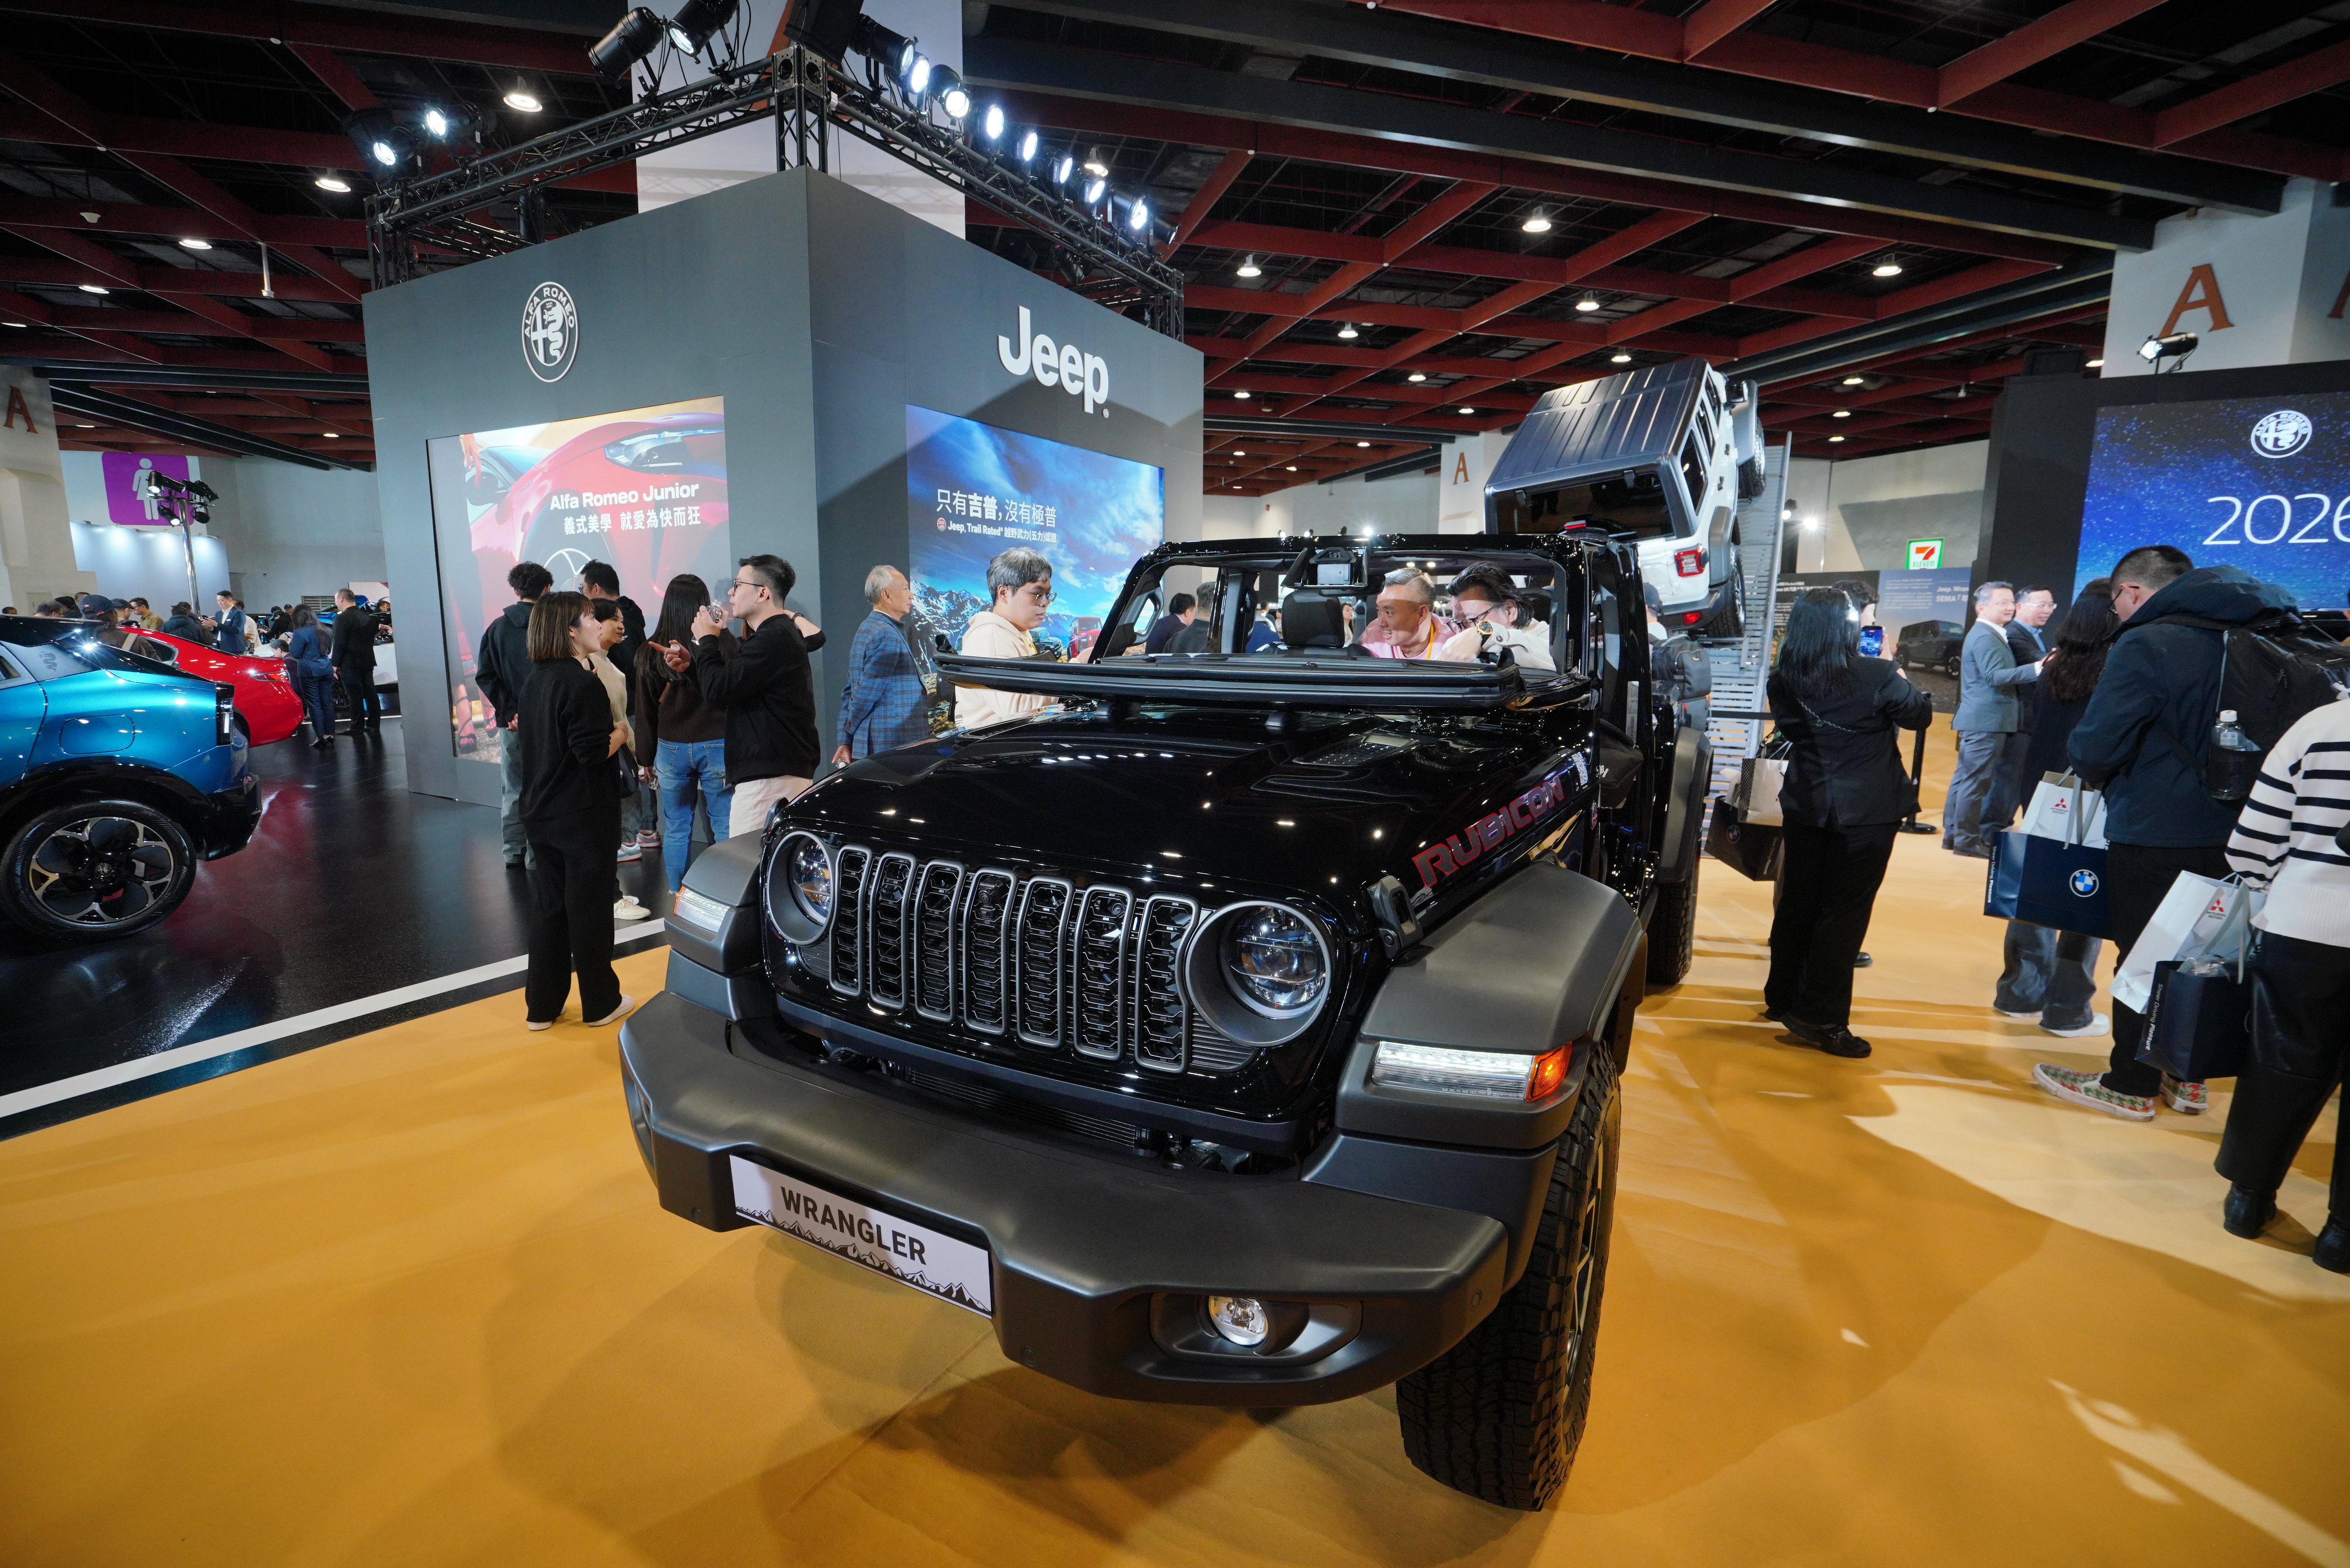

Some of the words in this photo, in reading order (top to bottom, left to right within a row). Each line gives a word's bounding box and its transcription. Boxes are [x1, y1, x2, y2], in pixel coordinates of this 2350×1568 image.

[524, 296, 542, 338] ALFA
[543, 287, 575, 328] ROMEO
[2159, 263, 2235, 337] A
[998, 306, 1109, 414] Jeep
[3, 386, 38, 434] A
[2280, 413, 2309, 434] ROMEO
[1453, 452, 1469, 485] A
[550, 493, 579, 510] Alfa
[582, 490, 639, 508] Romeo
[642, 482, 699, 502] Junior
[564, 513, 612, 535] 義式美學
[619, 506, 701, 531] 就愛為快而狂
[966, 523, 982, 534] Trail
[1915, 546, 1935, 561] 7
[1412, 775, 1564, 889] RUBICON
[2075, 871, 2096, 881] BMW
[2150, 1001, 2160, 1023] Driving
[2145, 1023, 2156, 1051] Pleasure
[780, 1186, 927, 1266] WRANGLER
